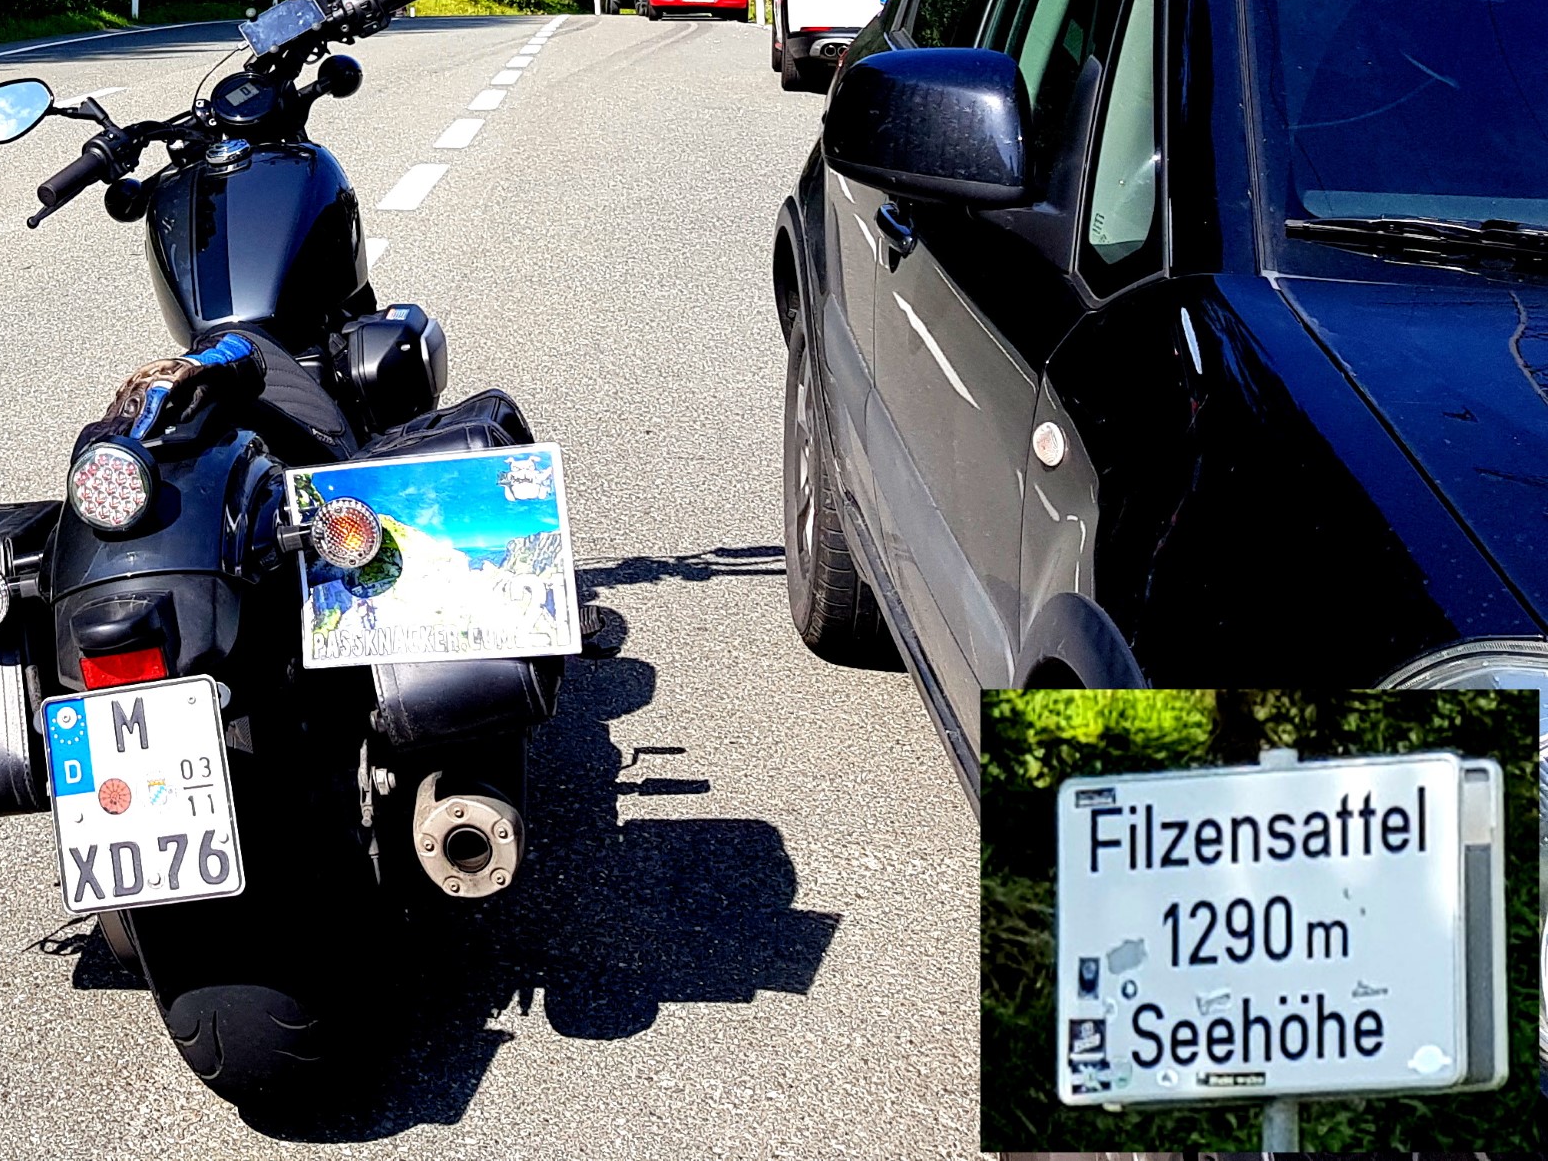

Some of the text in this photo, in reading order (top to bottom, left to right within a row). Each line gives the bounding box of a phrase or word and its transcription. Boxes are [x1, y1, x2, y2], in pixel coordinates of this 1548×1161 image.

[111, 696, 149, 753] M
[63, 759, 82, 784] D
[1089, 785, 1427, 874] Filzensattel
[1161, 895, 1349, 968] 1290 m
[1131, 992, 1385, 1070] Seehöhe
